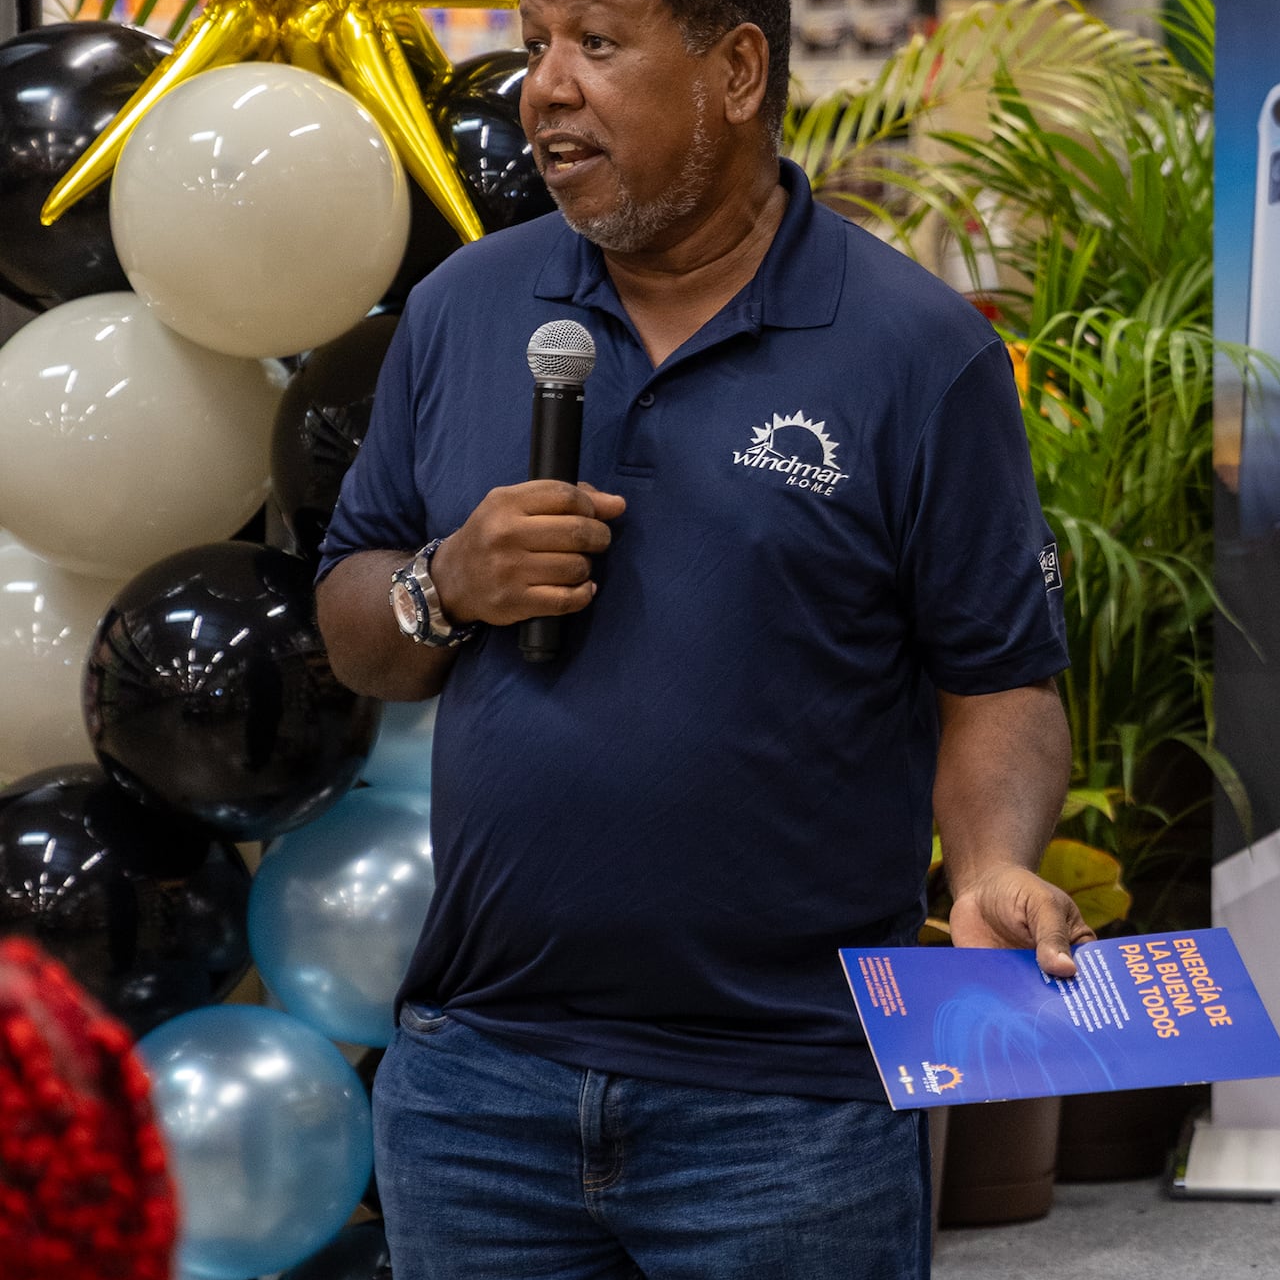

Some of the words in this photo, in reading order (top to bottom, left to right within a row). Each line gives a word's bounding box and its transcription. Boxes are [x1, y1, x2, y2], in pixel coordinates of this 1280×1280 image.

[733, 448, 850, 485] windmar
[785, 475, 835, 497] HOME
[1145, 940, 1172, 962] LA
[1118, 943, 1155, 986] PARA
[1138, 985, 1181, 1039] TODOS
[1155, 961, 1198, 1017] BUENA
[1172, 937, 1224, 1005] ENERGÍA
[1203, 1004, 1233, 1028] DE
